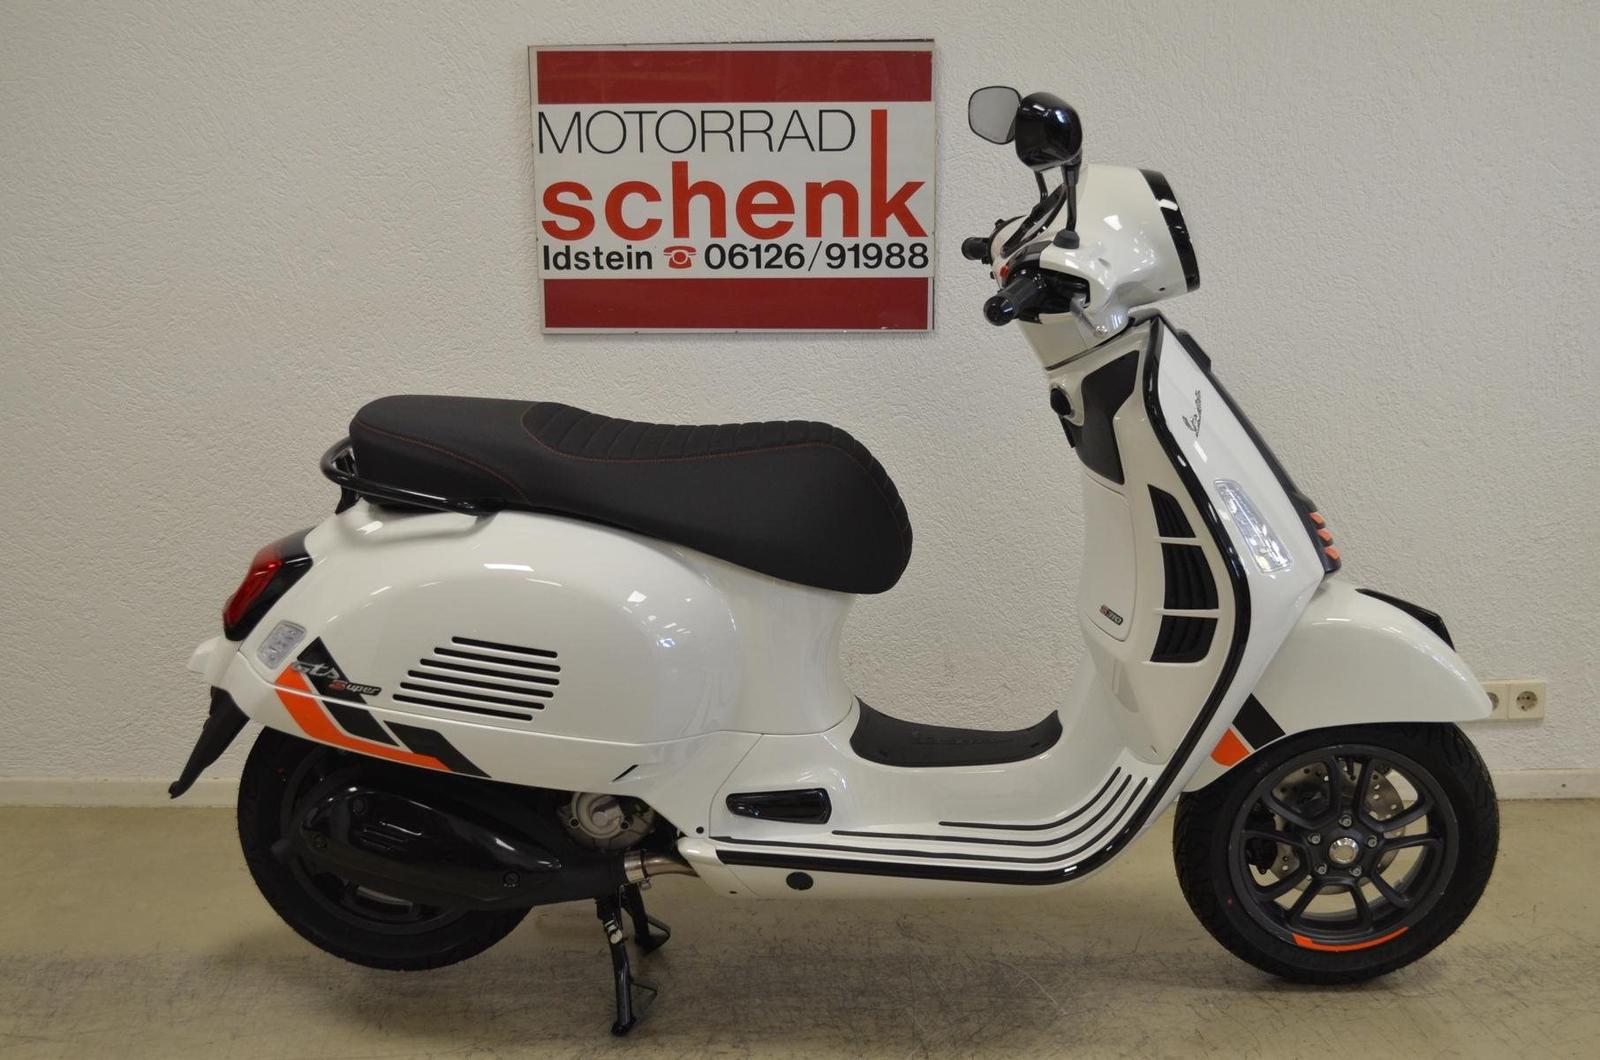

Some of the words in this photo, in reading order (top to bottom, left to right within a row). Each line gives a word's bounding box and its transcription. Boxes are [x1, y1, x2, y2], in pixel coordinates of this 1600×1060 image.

[538, 109, 856, 154] MOTORRAD
[541, 109, 928, 242] schenk
[543, 245, 653, 270] Idstein
[704, 241, 930, 272] 06126/91988
